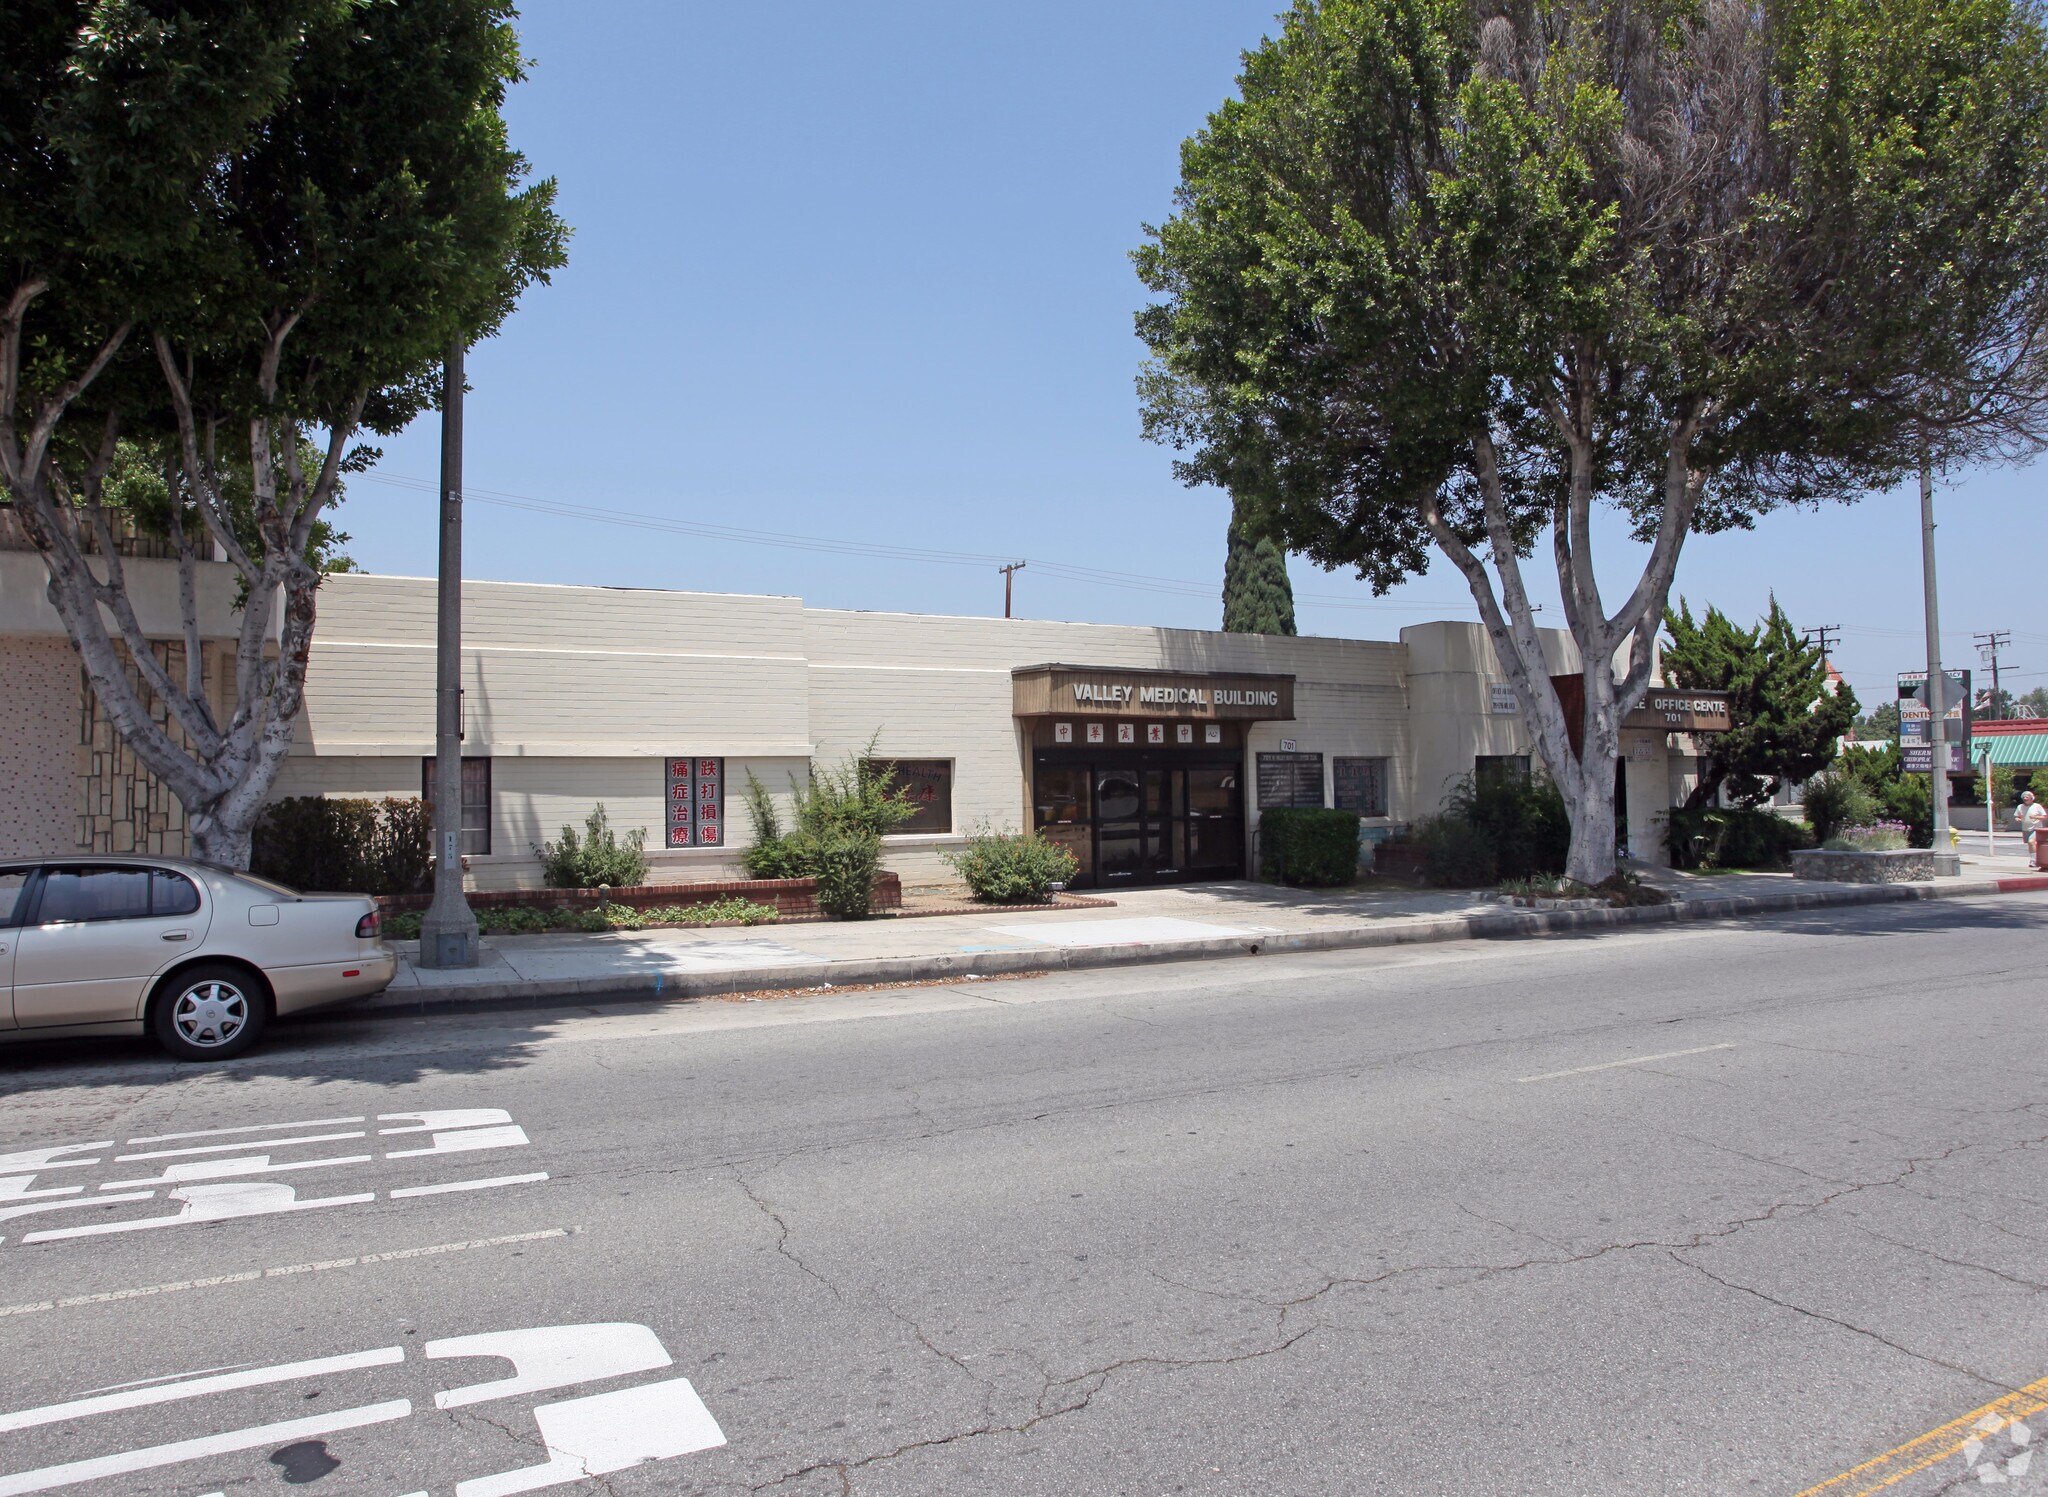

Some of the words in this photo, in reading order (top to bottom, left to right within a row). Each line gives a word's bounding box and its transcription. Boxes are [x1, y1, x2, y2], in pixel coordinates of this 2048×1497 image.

[1073, 684, 1132, 702] VALLEY
[1139, 686, 1207, 704] MEDICAL
[1213, 689, 1278, 706] BUILDING
[1654, 698, 1691, 711] OFFICE
[1664, 713, 1681, 722] 701
[1902, 711, 1932, 719] DENTIS
[1283, 741, 1294, 751] 701
[897, 765, 942, 782] HEALTH
[672, 761, 690, 844] 痛症治療
[700, 760, 718, 844] 跌打損傷
